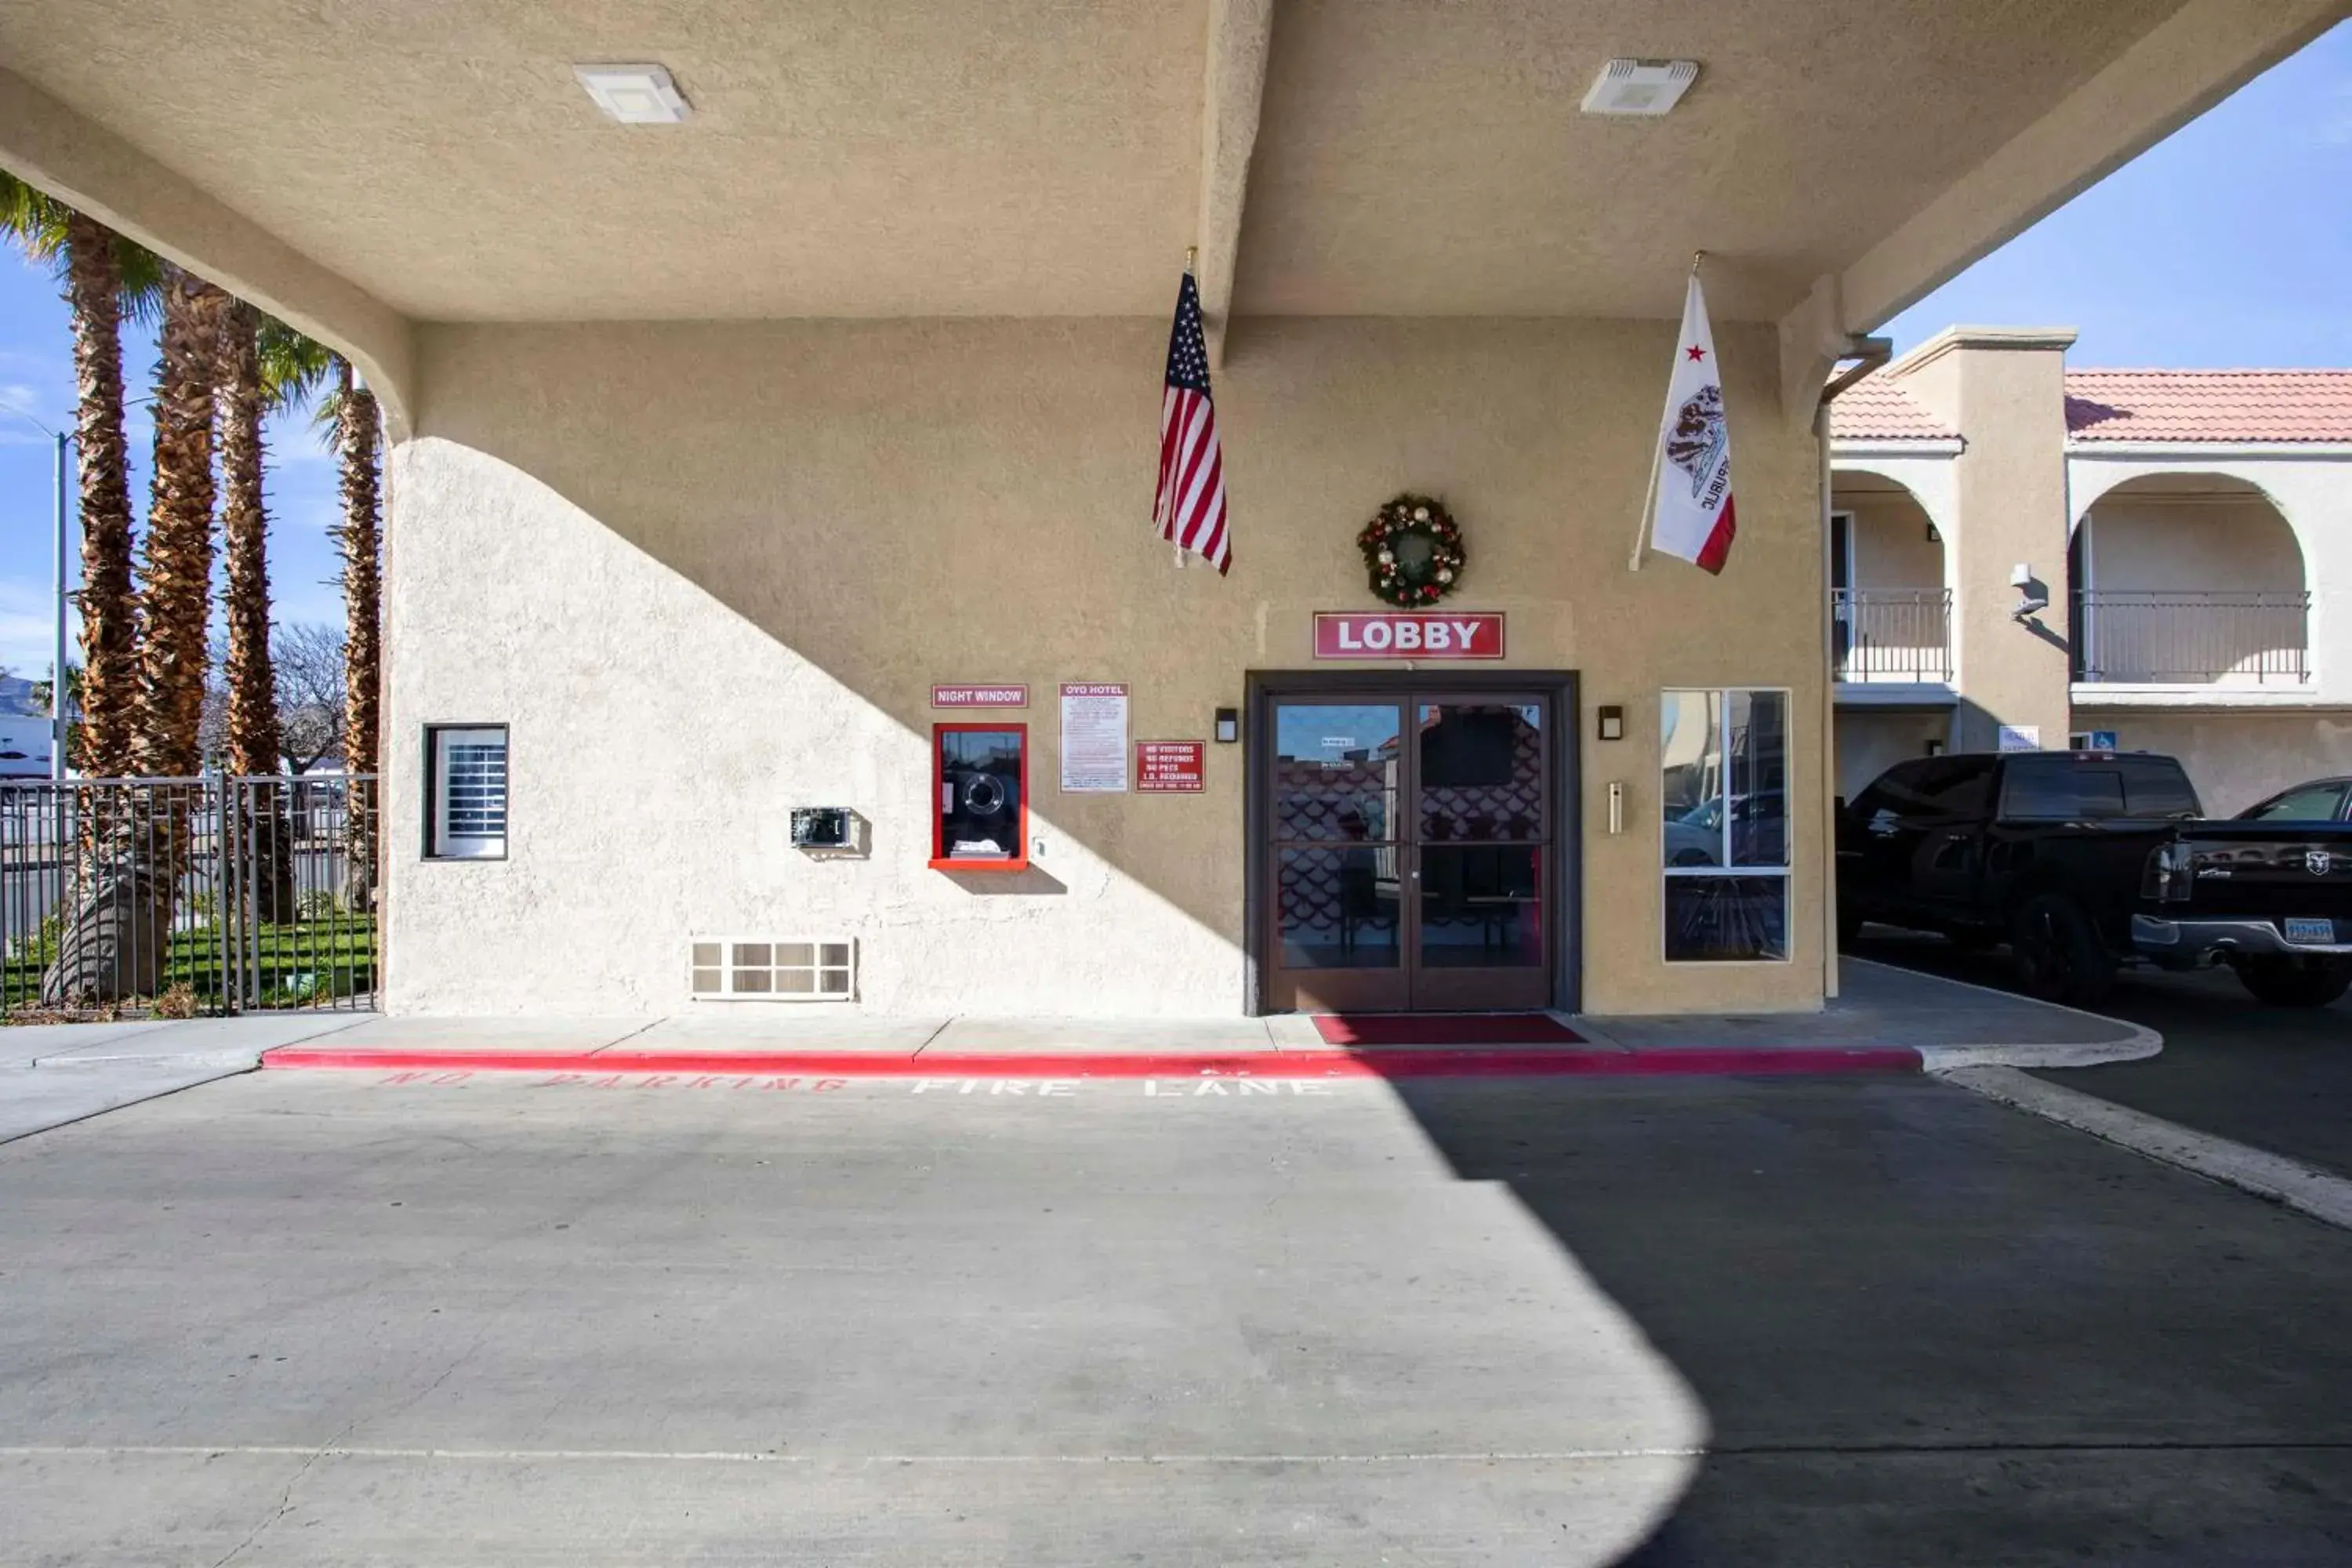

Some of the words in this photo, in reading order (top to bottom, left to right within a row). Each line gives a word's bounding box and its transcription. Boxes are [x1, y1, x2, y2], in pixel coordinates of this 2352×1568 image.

[1338, 621, 1480, 650] LOBBY
[938, 691, 972, 702] NIGHT
[975, 691, 1022, 702] WINDOW
[1066, 685, 1087, 695] OYO
[1090, 685, 1123, 695] HOTEL
[377, 1072, 475, 1084] NO
[537, 1073, 848, 1091] PARKING
[911, 1079, 1082, 1096] FIRE
[1144, 1079, 1332, 1096] LANE
